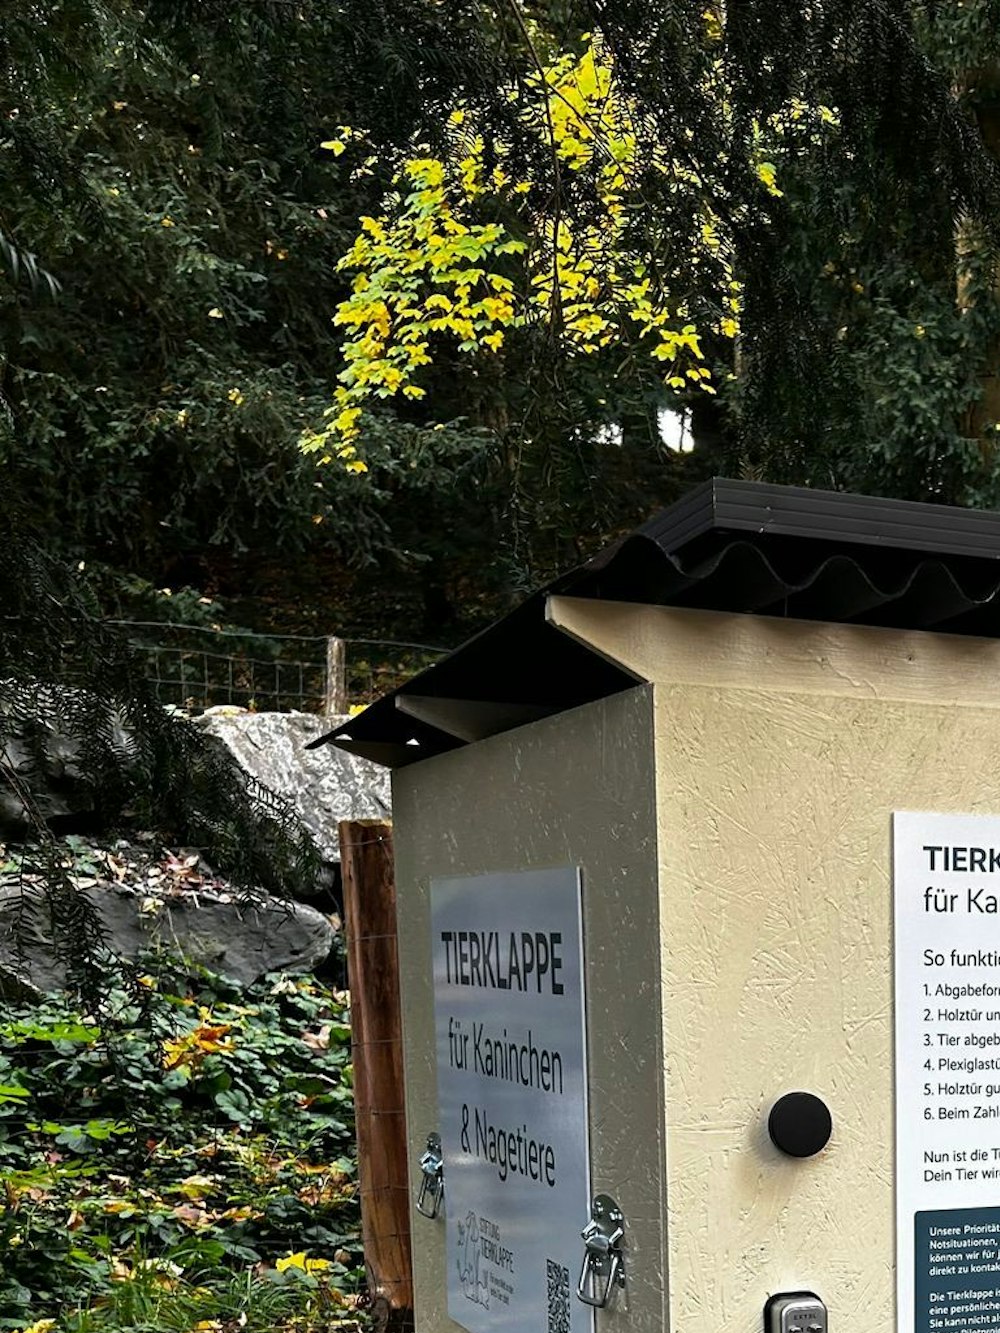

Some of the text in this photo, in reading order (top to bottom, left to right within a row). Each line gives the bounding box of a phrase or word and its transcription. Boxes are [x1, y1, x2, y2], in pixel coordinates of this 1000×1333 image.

[923, 886, 959, 913] für
[441, 932, 564, 995] TIERKLAPPE
[923, 948, 945, 967] So
[923, 983, 933, 996] 1.
[923, 1008, 935, 1021] 2.
[937, 1008, 983, 1021] Holztür
[923, 1033, 935, 1047] 3.
[936, 1033, 961, 1046] Tier
[448, 1016, 564, 1095] für Kaninchen
[923, 1058, 935, 1071] 4.
[923, 1082, 935, 1096] 5.
[938, 1082, 983, 1095] Holztür
[924, 1107, 935, 1120] 6.
[938, 1107, 969, 1120] Beim
[461, 1103, 556, 1188] & Nagetiere
[923, 1150, 949, 1163] Nun
[953, 1150, 967, 1162] ist
[970, 1149, 989, 1162] die
[923, 1169, 952, 1182] Dein
[954, 1168, 978, 1180] Tier
[929, 1226, 961, 1236] Unsere
[963, 1223, 1000, 1234] Priorität
[929, 1253, 963, 1263] können
[965, 1250, 980, 1260] wir
[982, 1249, 996, 1259] für
[928, 1265, 956, 1276] direkt
[957, 1266, 969, 1274] zu
[929, 1292, 945, 1302] Die
[946, 1289, 994, 1300] Tierklappe
[928, 1305, 949, 1315] eine
[950, 1301, 1000, 1316] persönliche
[929, 1318, 944, 1329] Sie
[944, 1317, 967, 1327] kann
[967, 1314, 990, 1325] nicht
